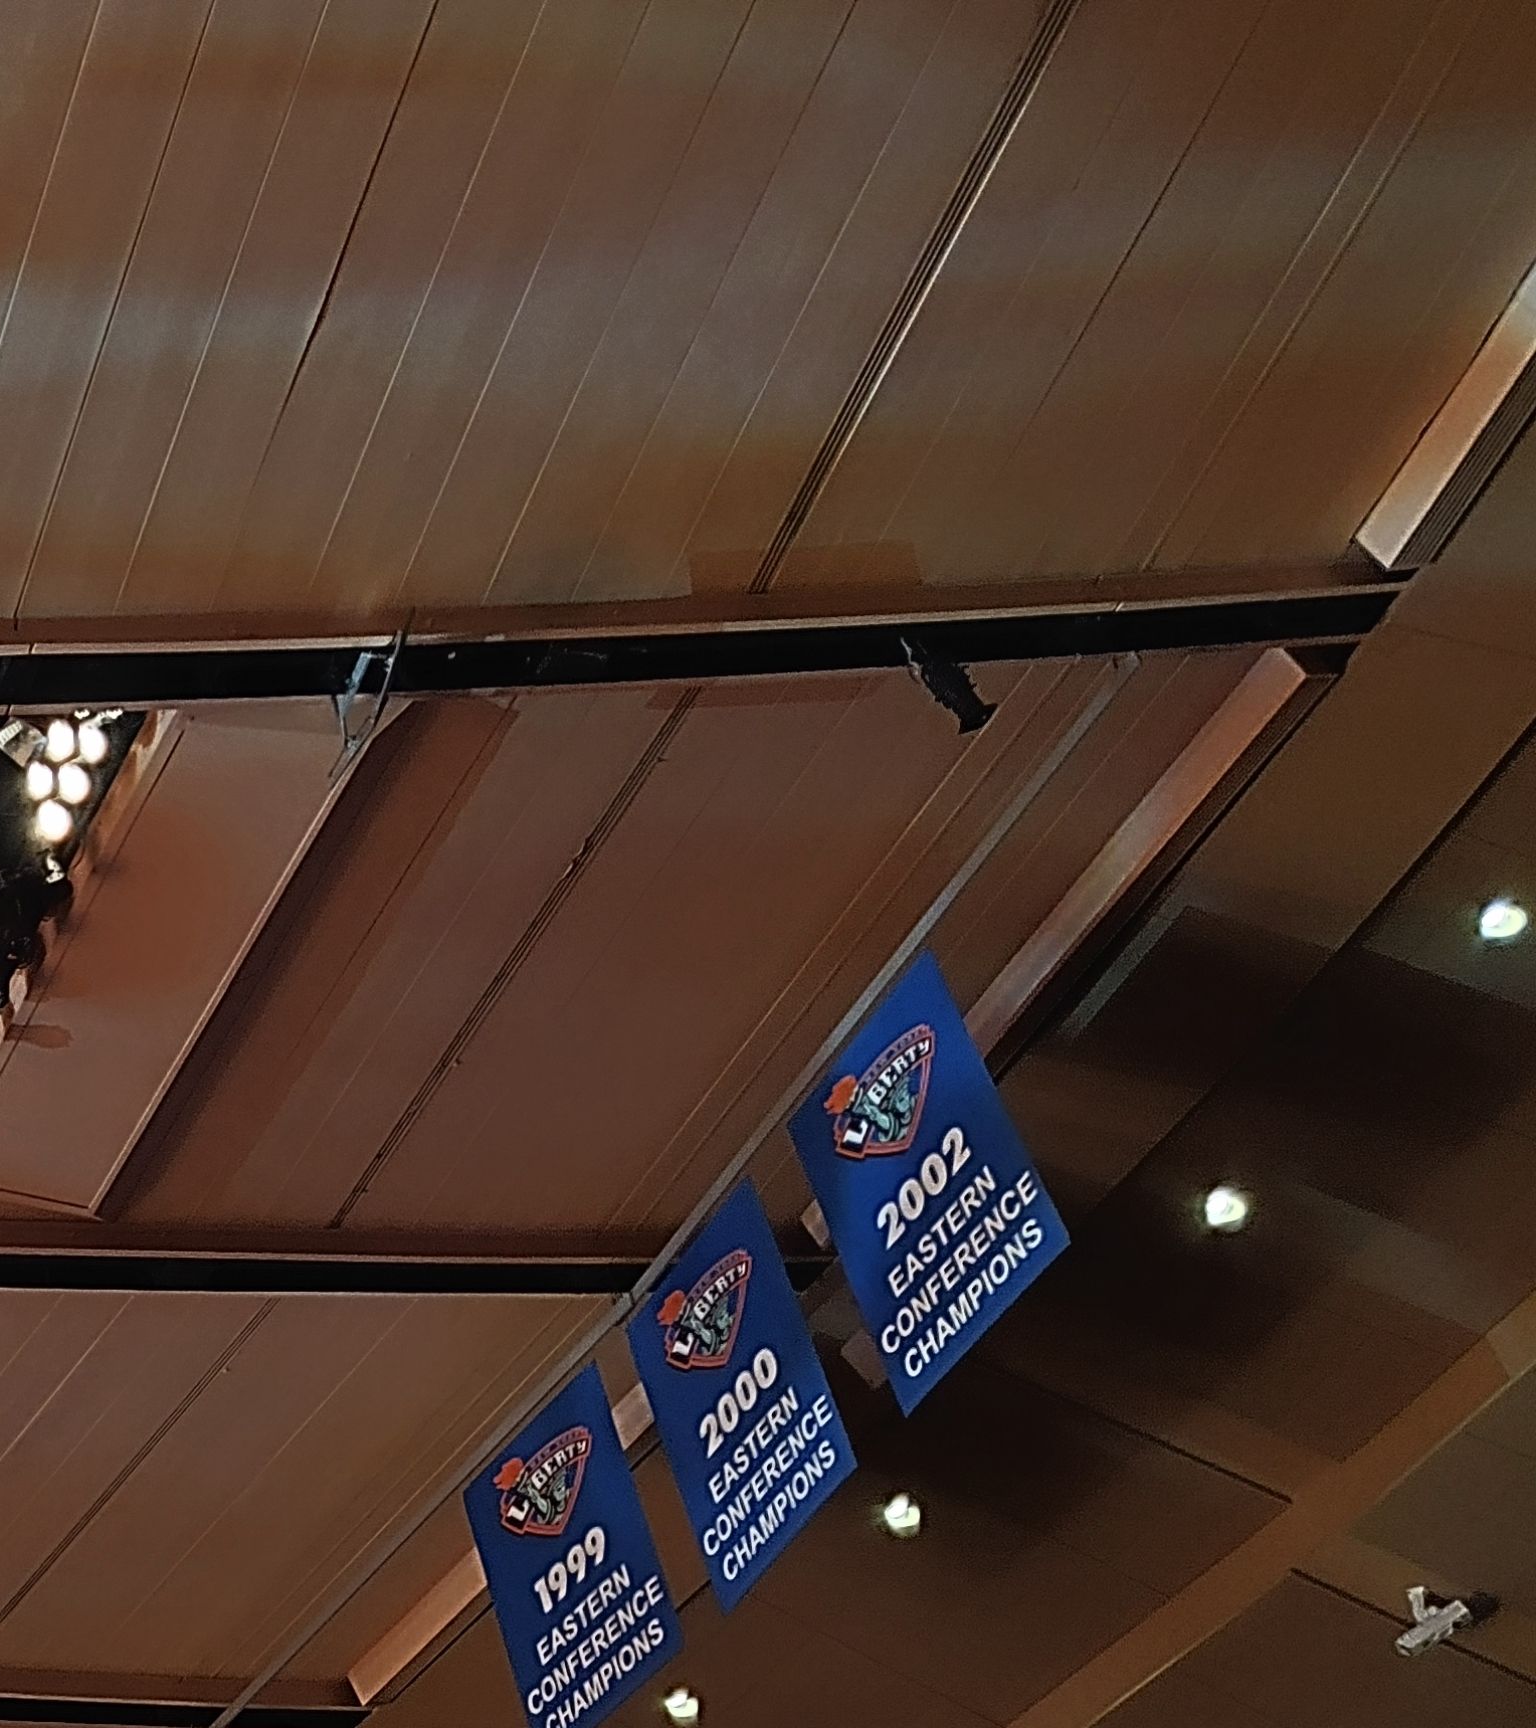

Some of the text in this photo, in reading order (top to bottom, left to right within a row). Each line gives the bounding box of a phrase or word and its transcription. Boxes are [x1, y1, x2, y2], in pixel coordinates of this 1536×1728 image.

[877, 1126, 972, 1250] 2002
[888, 1165, 996, 1299] EASTERN
[880, 1170, 1039, 1354] CONFERENCE
[904, 1218, 1044, 1378] CHAMPIONS
[700, 1347, 778, 1458] 2000
[707, 1386, 800, 1503] EASTERN
[702, 1394, 834, 1557] CONFERENCE
[722, 1440, 836, 1582] CHAMPIONS
[533, 1526, 606, 1614] 1999
[537, 1563, 630, 1665] EASTERN
[528, 1575, 664, 1715] CONFERENCE
